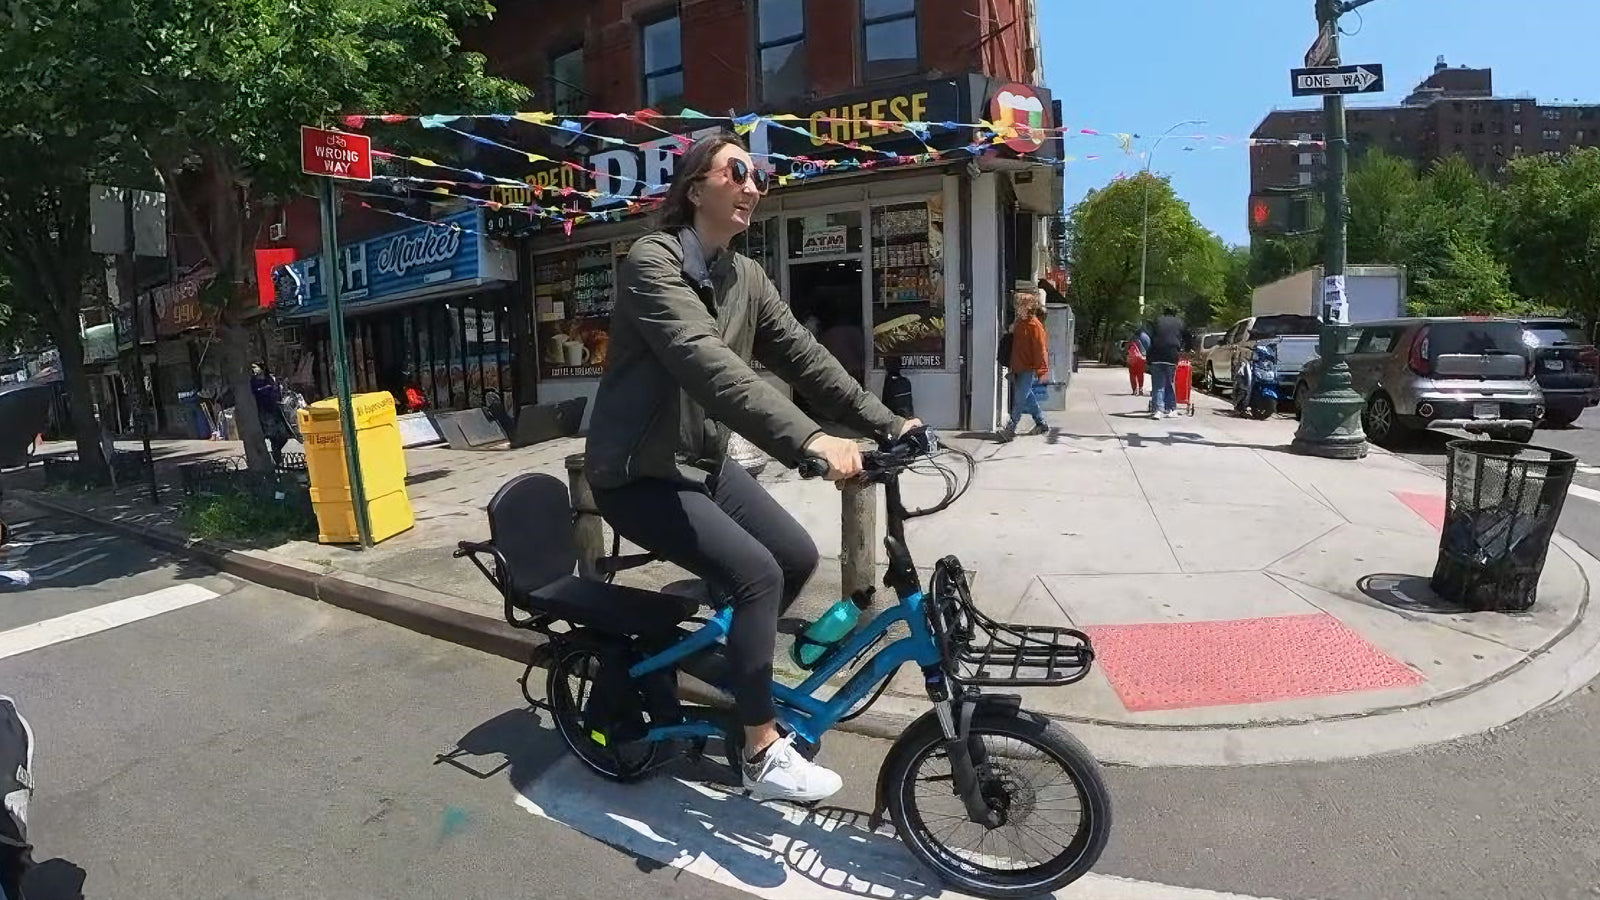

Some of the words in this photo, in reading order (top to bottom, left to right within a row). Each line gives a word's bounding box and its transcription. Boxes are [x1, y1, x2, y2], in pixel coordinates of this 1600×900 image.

[1305, 75, 1331, 87] ONE
[1342, 73, 1370, 86] WAY
[810, 92, 928, 147] CHEESE
[315, 145, 359, 163] WRONG
[324, 160, 351, 173] WAY
[804, 235, 844, 248] ATM
[303, 244, 367, 300] FIH
[377, 222, 460, 276] Market
